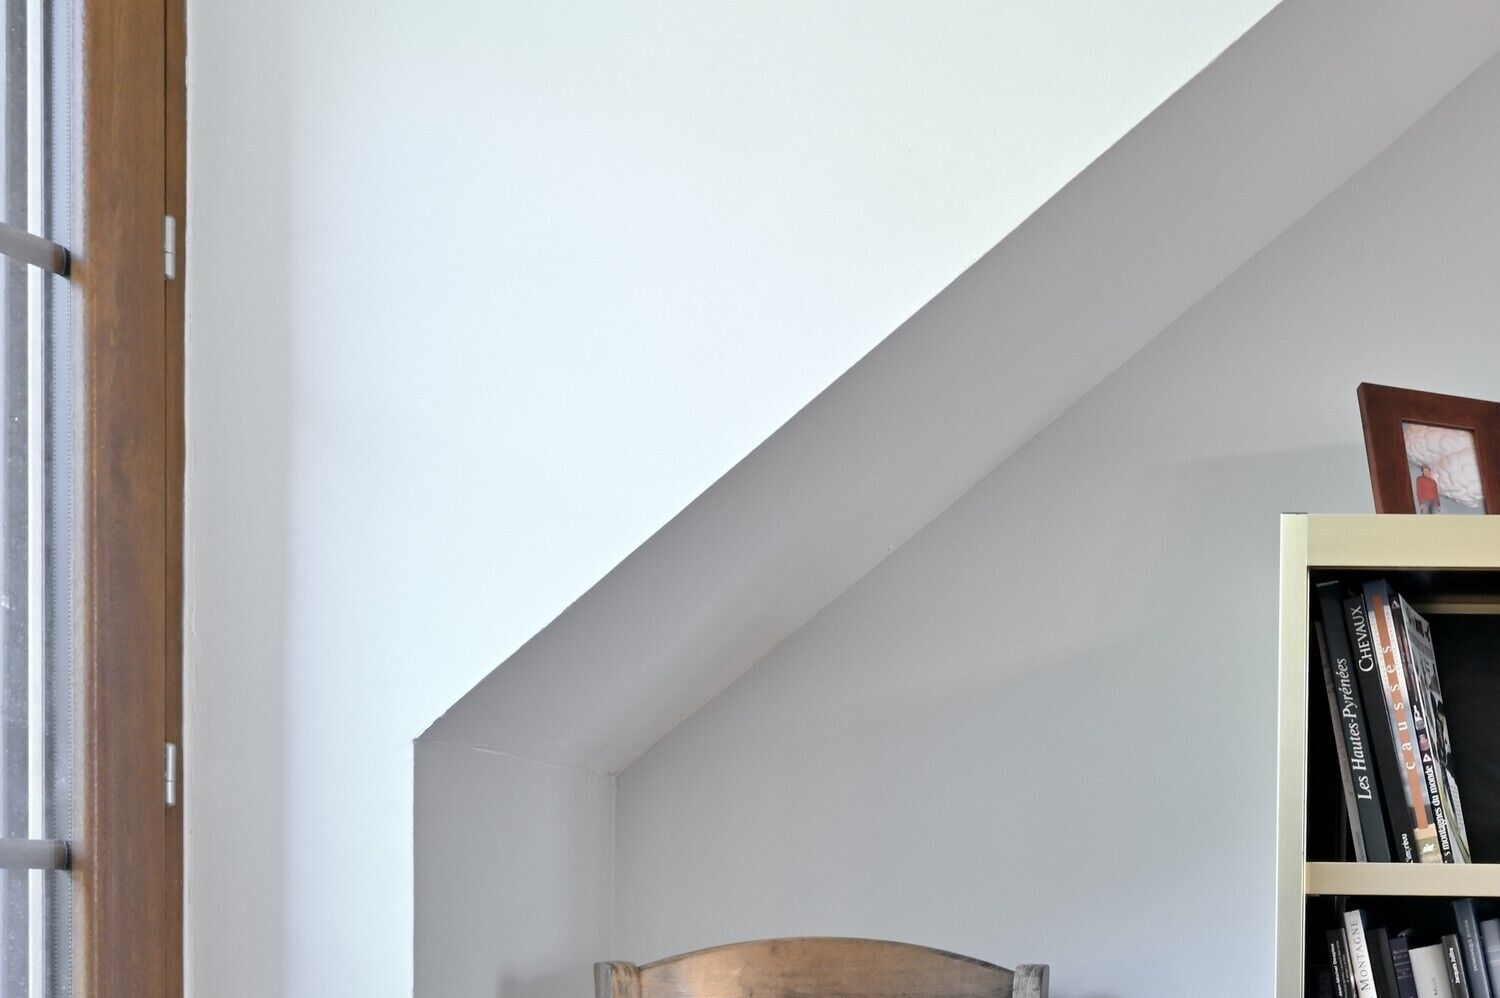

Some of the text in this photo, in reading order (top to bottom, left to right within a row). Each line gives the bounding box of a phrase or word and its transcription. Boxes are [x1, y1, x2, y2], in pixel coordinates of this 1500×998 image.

[1350, 605, 1374, 672] CHEVAUX
[1336, 657, 1372, 800] Les Hautes-Pyrénées
[1425, 766, 1438, 793] monde
[1431, 795, 1440, 806] du
[1434, 807, 1450, 850] montagnes
[1350, 920, 1373, 992] MONTAGNE
